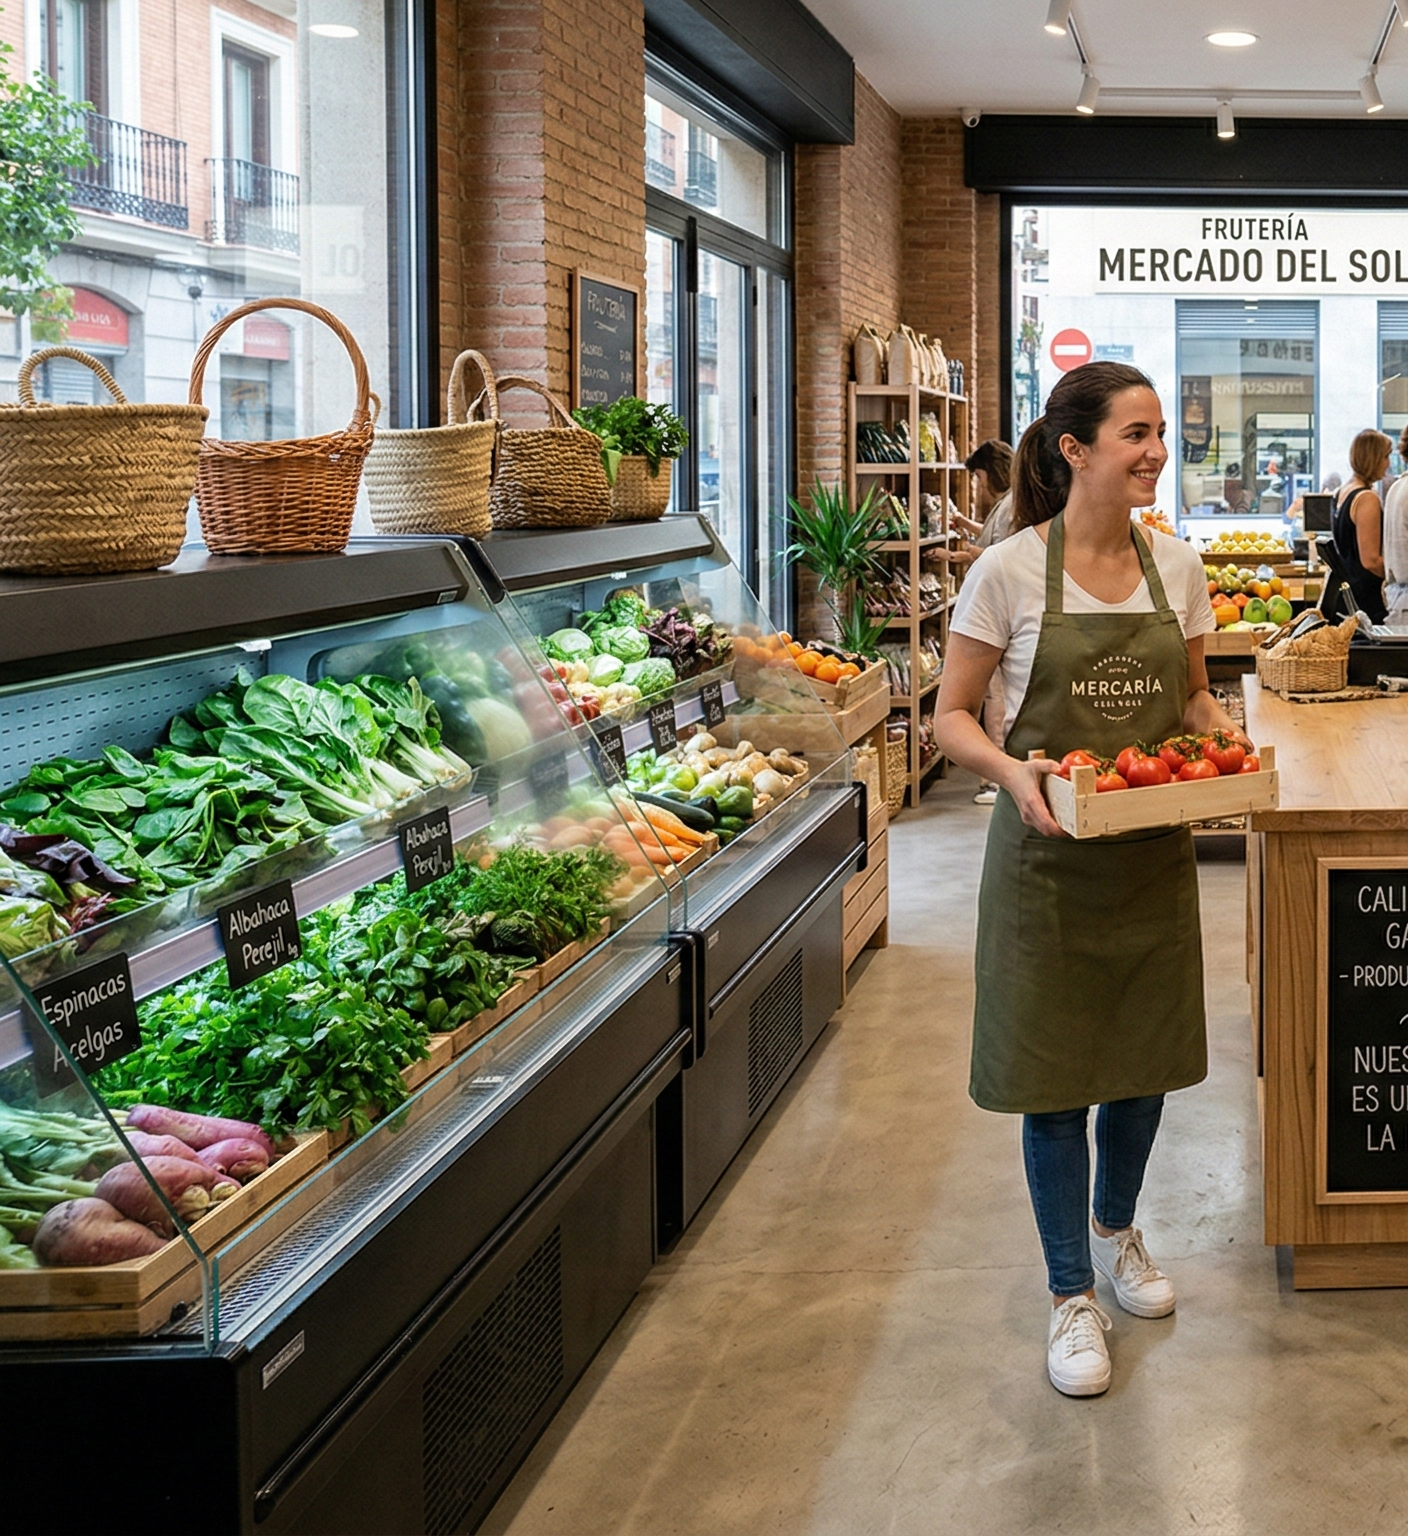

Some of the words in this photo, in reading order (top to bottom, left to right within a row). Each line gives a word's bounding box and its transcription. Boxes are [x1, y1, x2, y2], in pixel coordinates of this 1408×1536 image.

[1202, 212, 1309, 241] FRUTERÍA
[1099, 248, 1263, 282] MERCADO
[1277, 249, 1337, 282] DEL
[1071, 674, 1163, 696] MERCARÍA
[229, 899, 291, 940] Albahaca
[242, 926, 285, 970] Perejil
[41, 973, 126, 1027] Espinacas
[1352, 1085, 1380, 1112] ES
[1367, 1123, 1396, 1151] LA
